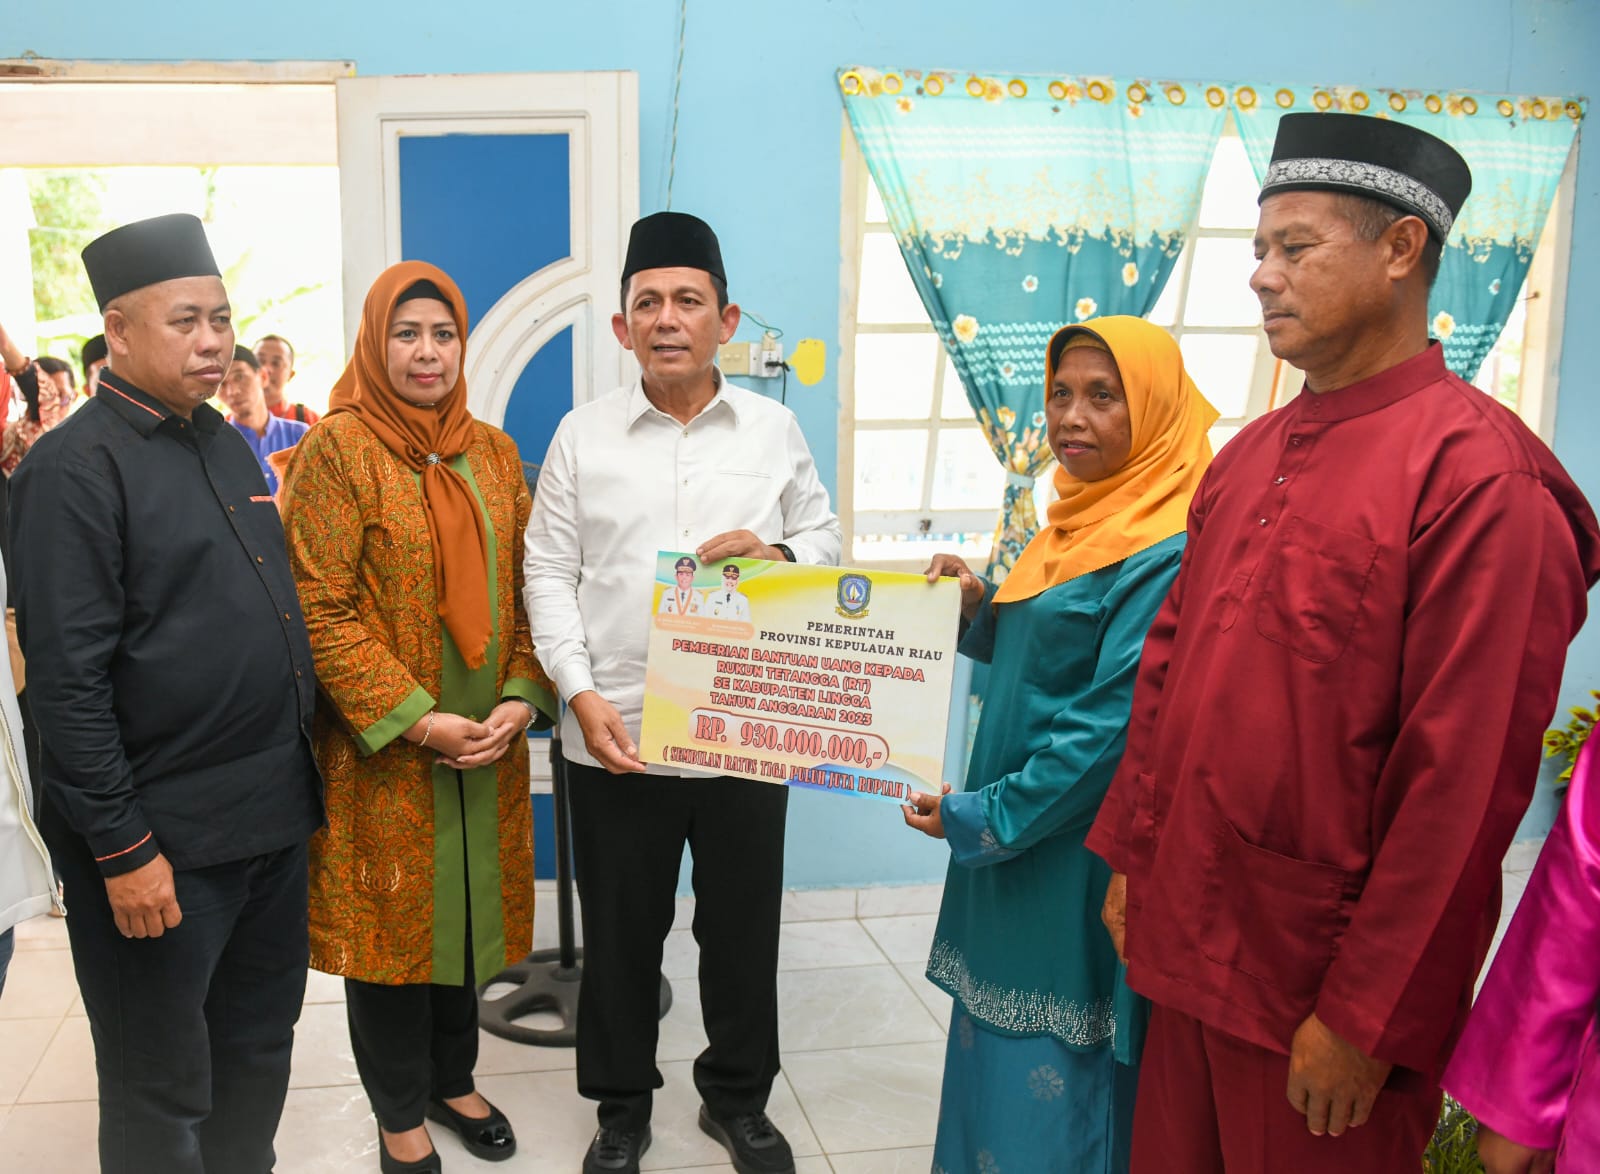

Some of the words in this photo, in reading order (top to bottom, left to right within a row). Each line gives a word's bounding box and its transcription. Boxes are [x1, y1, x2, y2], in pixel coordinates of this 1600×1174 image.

[760, 631, 821, 646] PROVINSI
[825, 637, 904, 656] KEPULAUAN
[908, 648, 943, 661] RIAU
[807, 621, 895, 640] PEMERINTAH
[672, 639, 748, 660] PEMBERIAN
[752, 649, 819, 669] BANTUAN
[821, 658, 861, 673] UANG
[865, 663, 925, 682] KEPADA
[713, 677, 730, 689] SE
[733, 679, 816, 701] KABUPATEN
[819, 691, 871, 709] LINGGA
[717, 661, 763, 677] RUKUN
[766, 667, 839, 688] TETANGGA
[843, 676, 871, 694] (RT)
[710, 692, 756, 709] TAHUN
[758, 699, 836, 720] ANGGARAN
[839, 710, 872, 725] 2023
[696, 714, 727, 743] RP.
[740, 722, 882, 768] 930.000.000,-
[670, 747, 722, 768] SEMBILAN
[724, 753, 758, 772] RATUS
[760, 760, 786, 778] TIGA
[789, 766, 826, 786] PULUH
[828, 772, 854, 790] JUTA
[858, 777, 903, 798] RUPIAH
